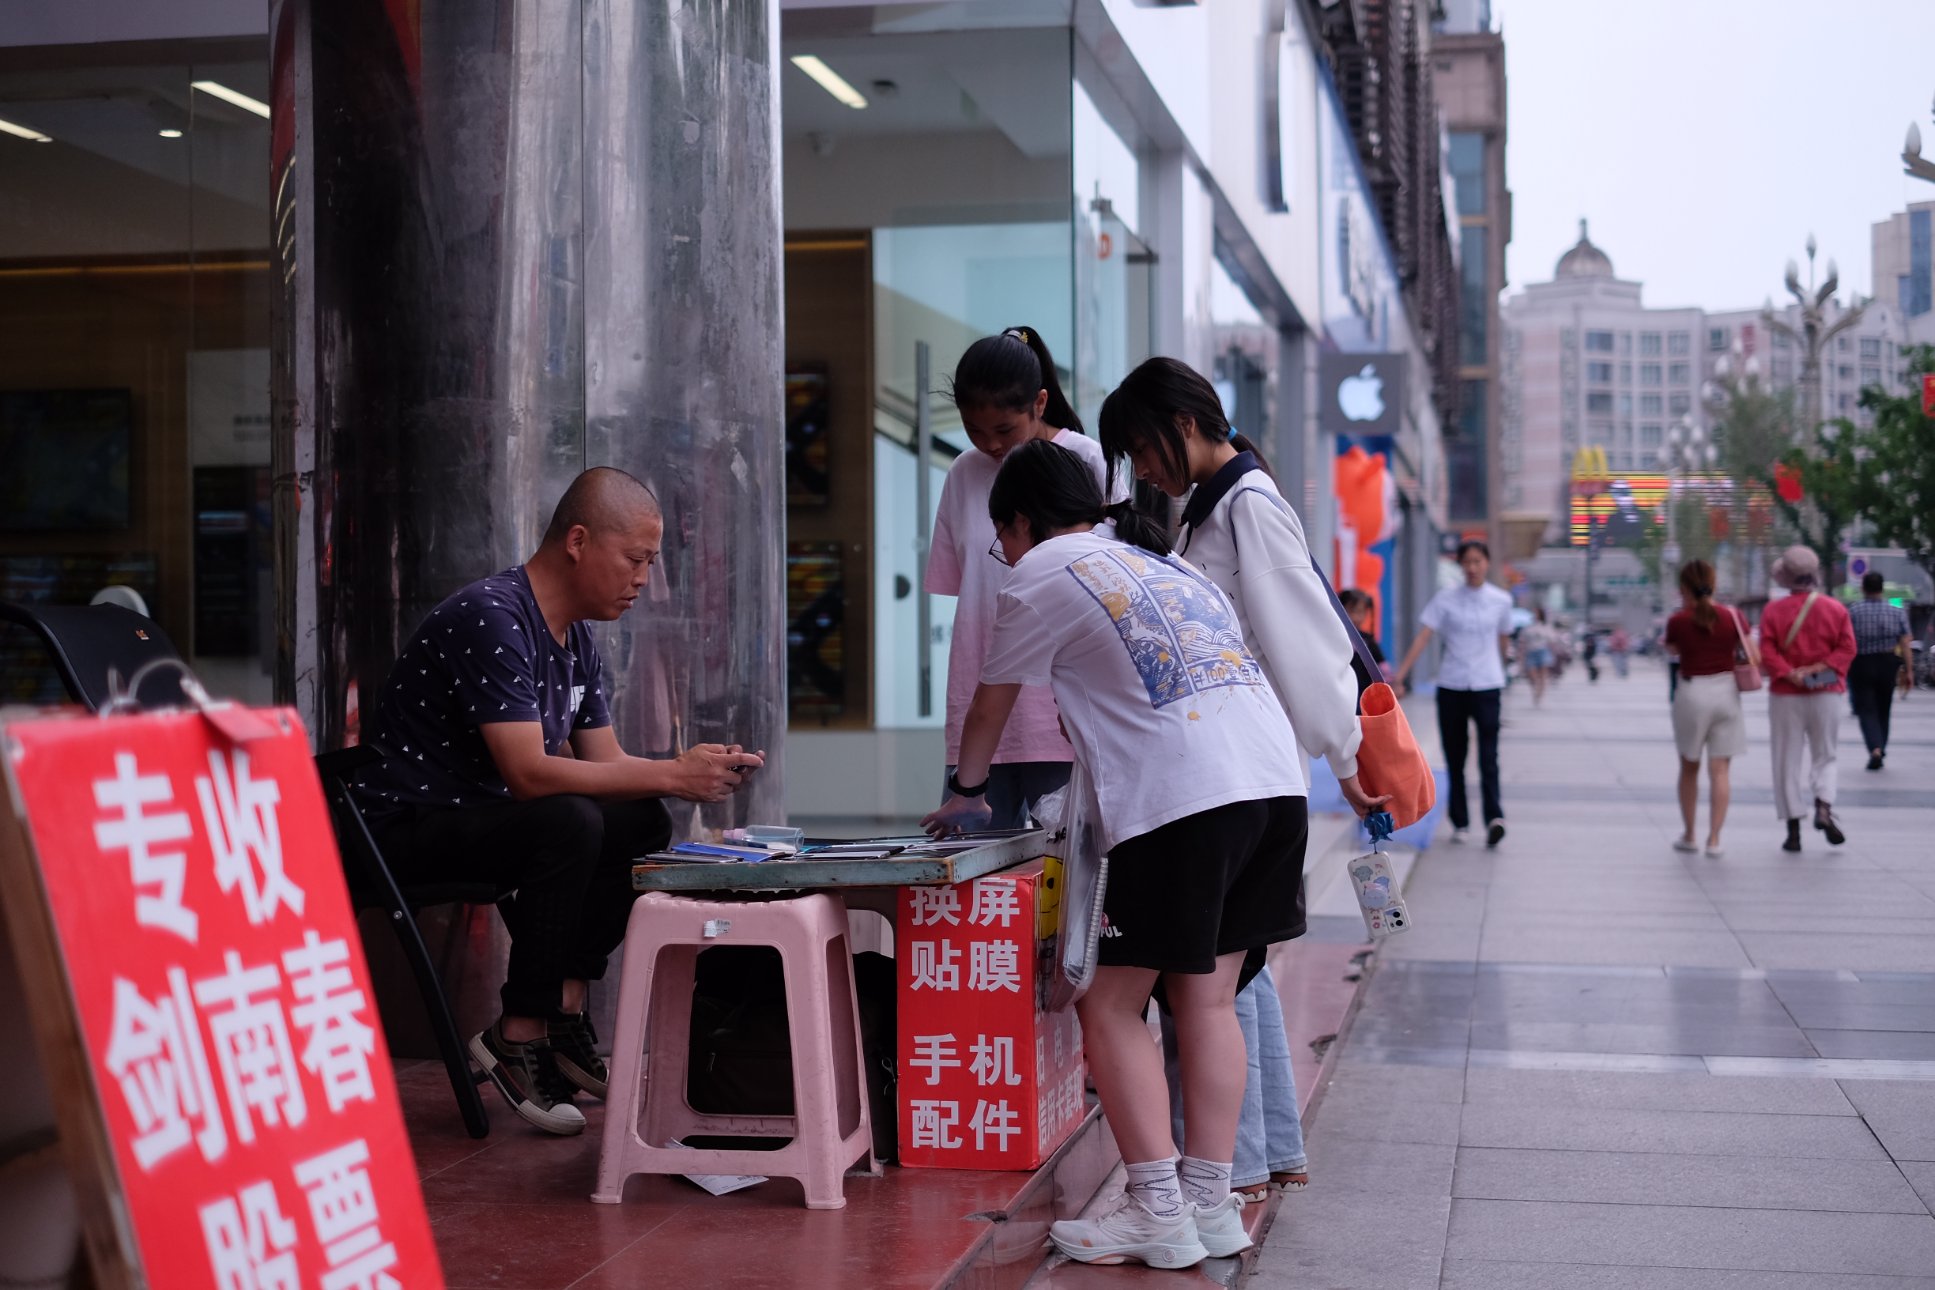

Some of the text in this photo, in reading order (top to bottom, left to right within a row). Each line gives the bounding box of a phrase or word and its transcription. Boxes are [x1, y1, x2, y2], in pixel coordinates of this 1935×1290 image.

[92, 748, 306, 944] 专收
[910, 878, 1021, 928] 换屏
[910, 939, 1021, 993] 贴膜
[105, 930, 376, 1171] 剑南春
[910, 1033, 1022, 1086] 手机
[910, 1099, 1022, 1152] 配件
[199, 1139, 398, 1290] 股票
